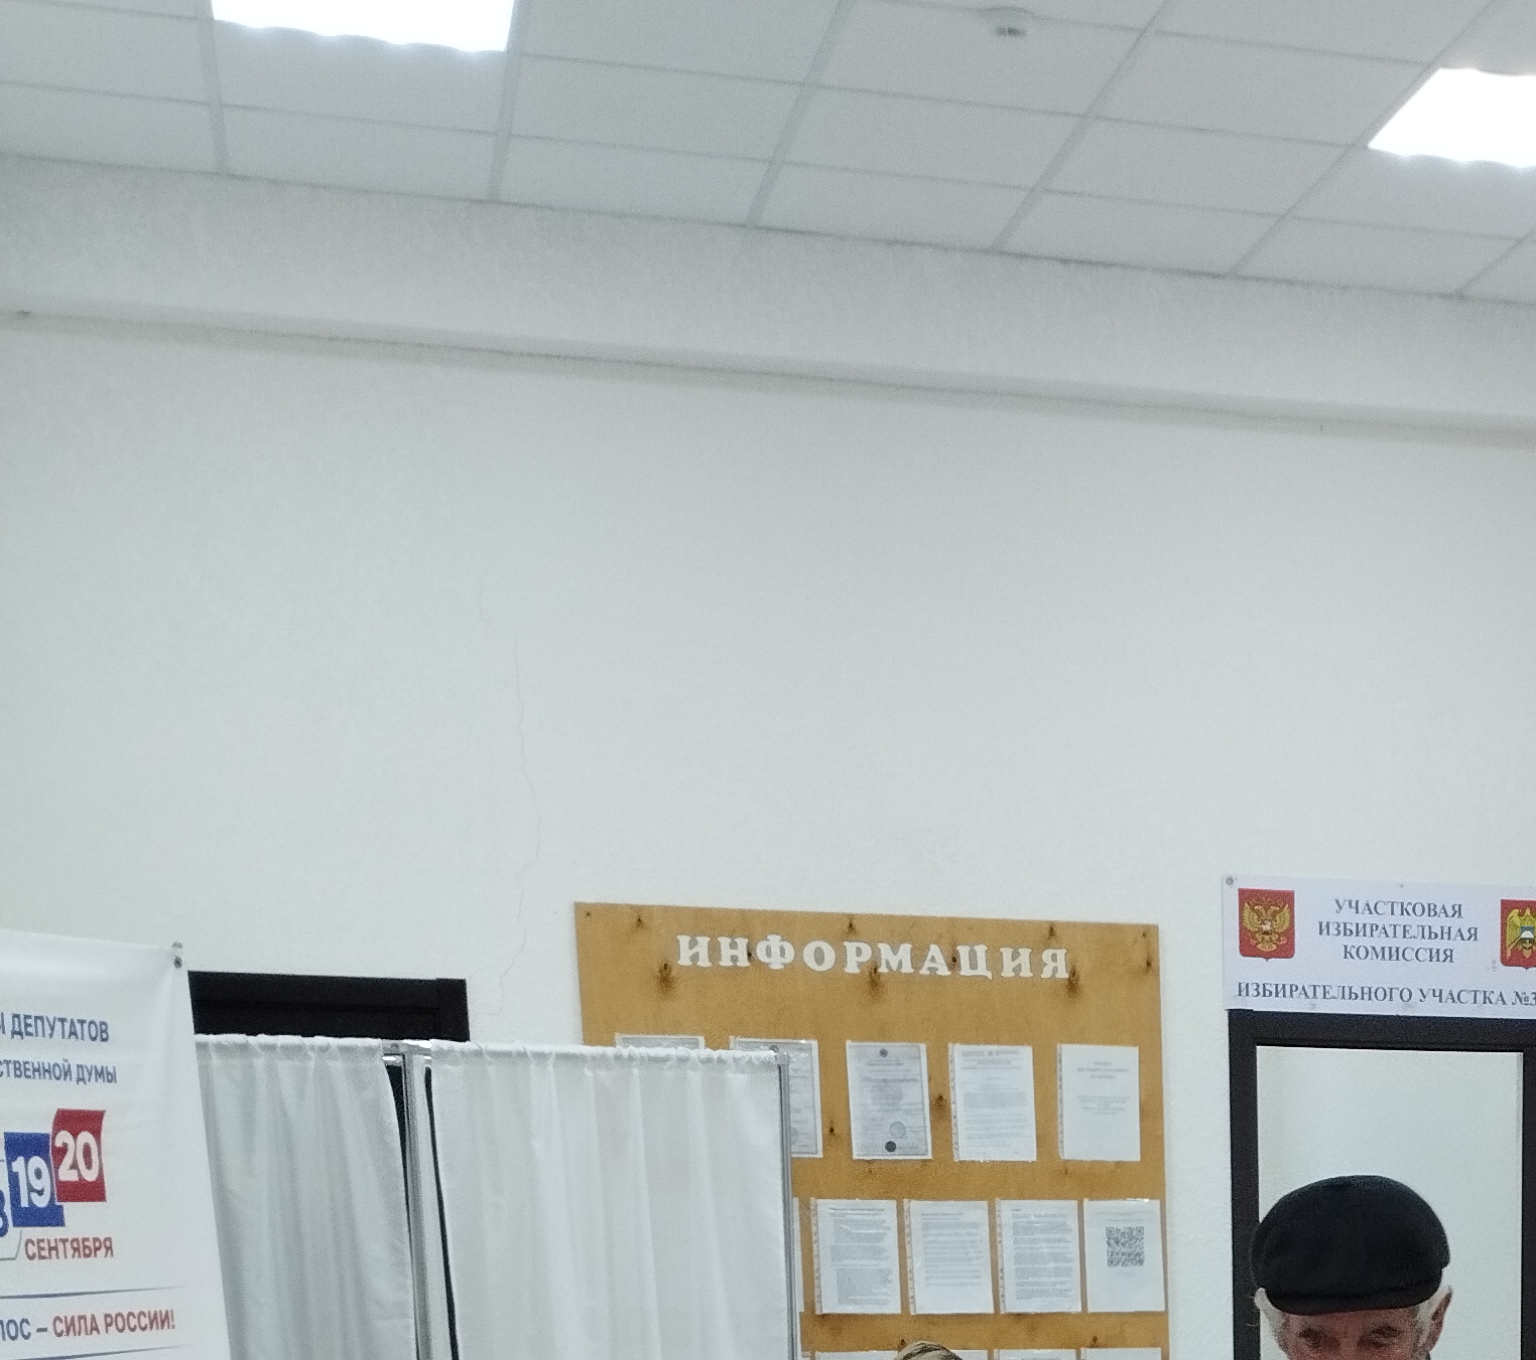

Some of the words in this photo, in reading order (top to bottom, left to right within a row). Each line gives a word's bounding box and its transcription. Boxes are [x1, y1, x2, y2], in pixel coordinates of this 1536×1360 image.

[1333, 898, 1464, 919] УЧАСТКОВАЯ
[1317, 920, 1479, 943] ИЗБИРАТЕЛЬНАЯ
[676, 934, 1069, 981] ИНФОРМАЦИЯ
[1342, 944, 1456, 964] КОМИССИЯ
[1236, 981, 1414, 1004] ИЗБИРАТЕЛЬНОГО
[1417, 986, 1508, 1007] УЧАСТКА
[10, 1012, 110, 1042] ДЕПУТАТОВ
[75, 1063, 118, 1085] ДУМЫ
[54, 1130, 100, 1182] 20
[11, 1155, 51, 1208] 19
[24, 1236, 115, 1261] СЕНТЯБРЯ
[52, 1313, 101, 1338] СИЛА
[103, 1308, 176, 1335] РОССИИ!
